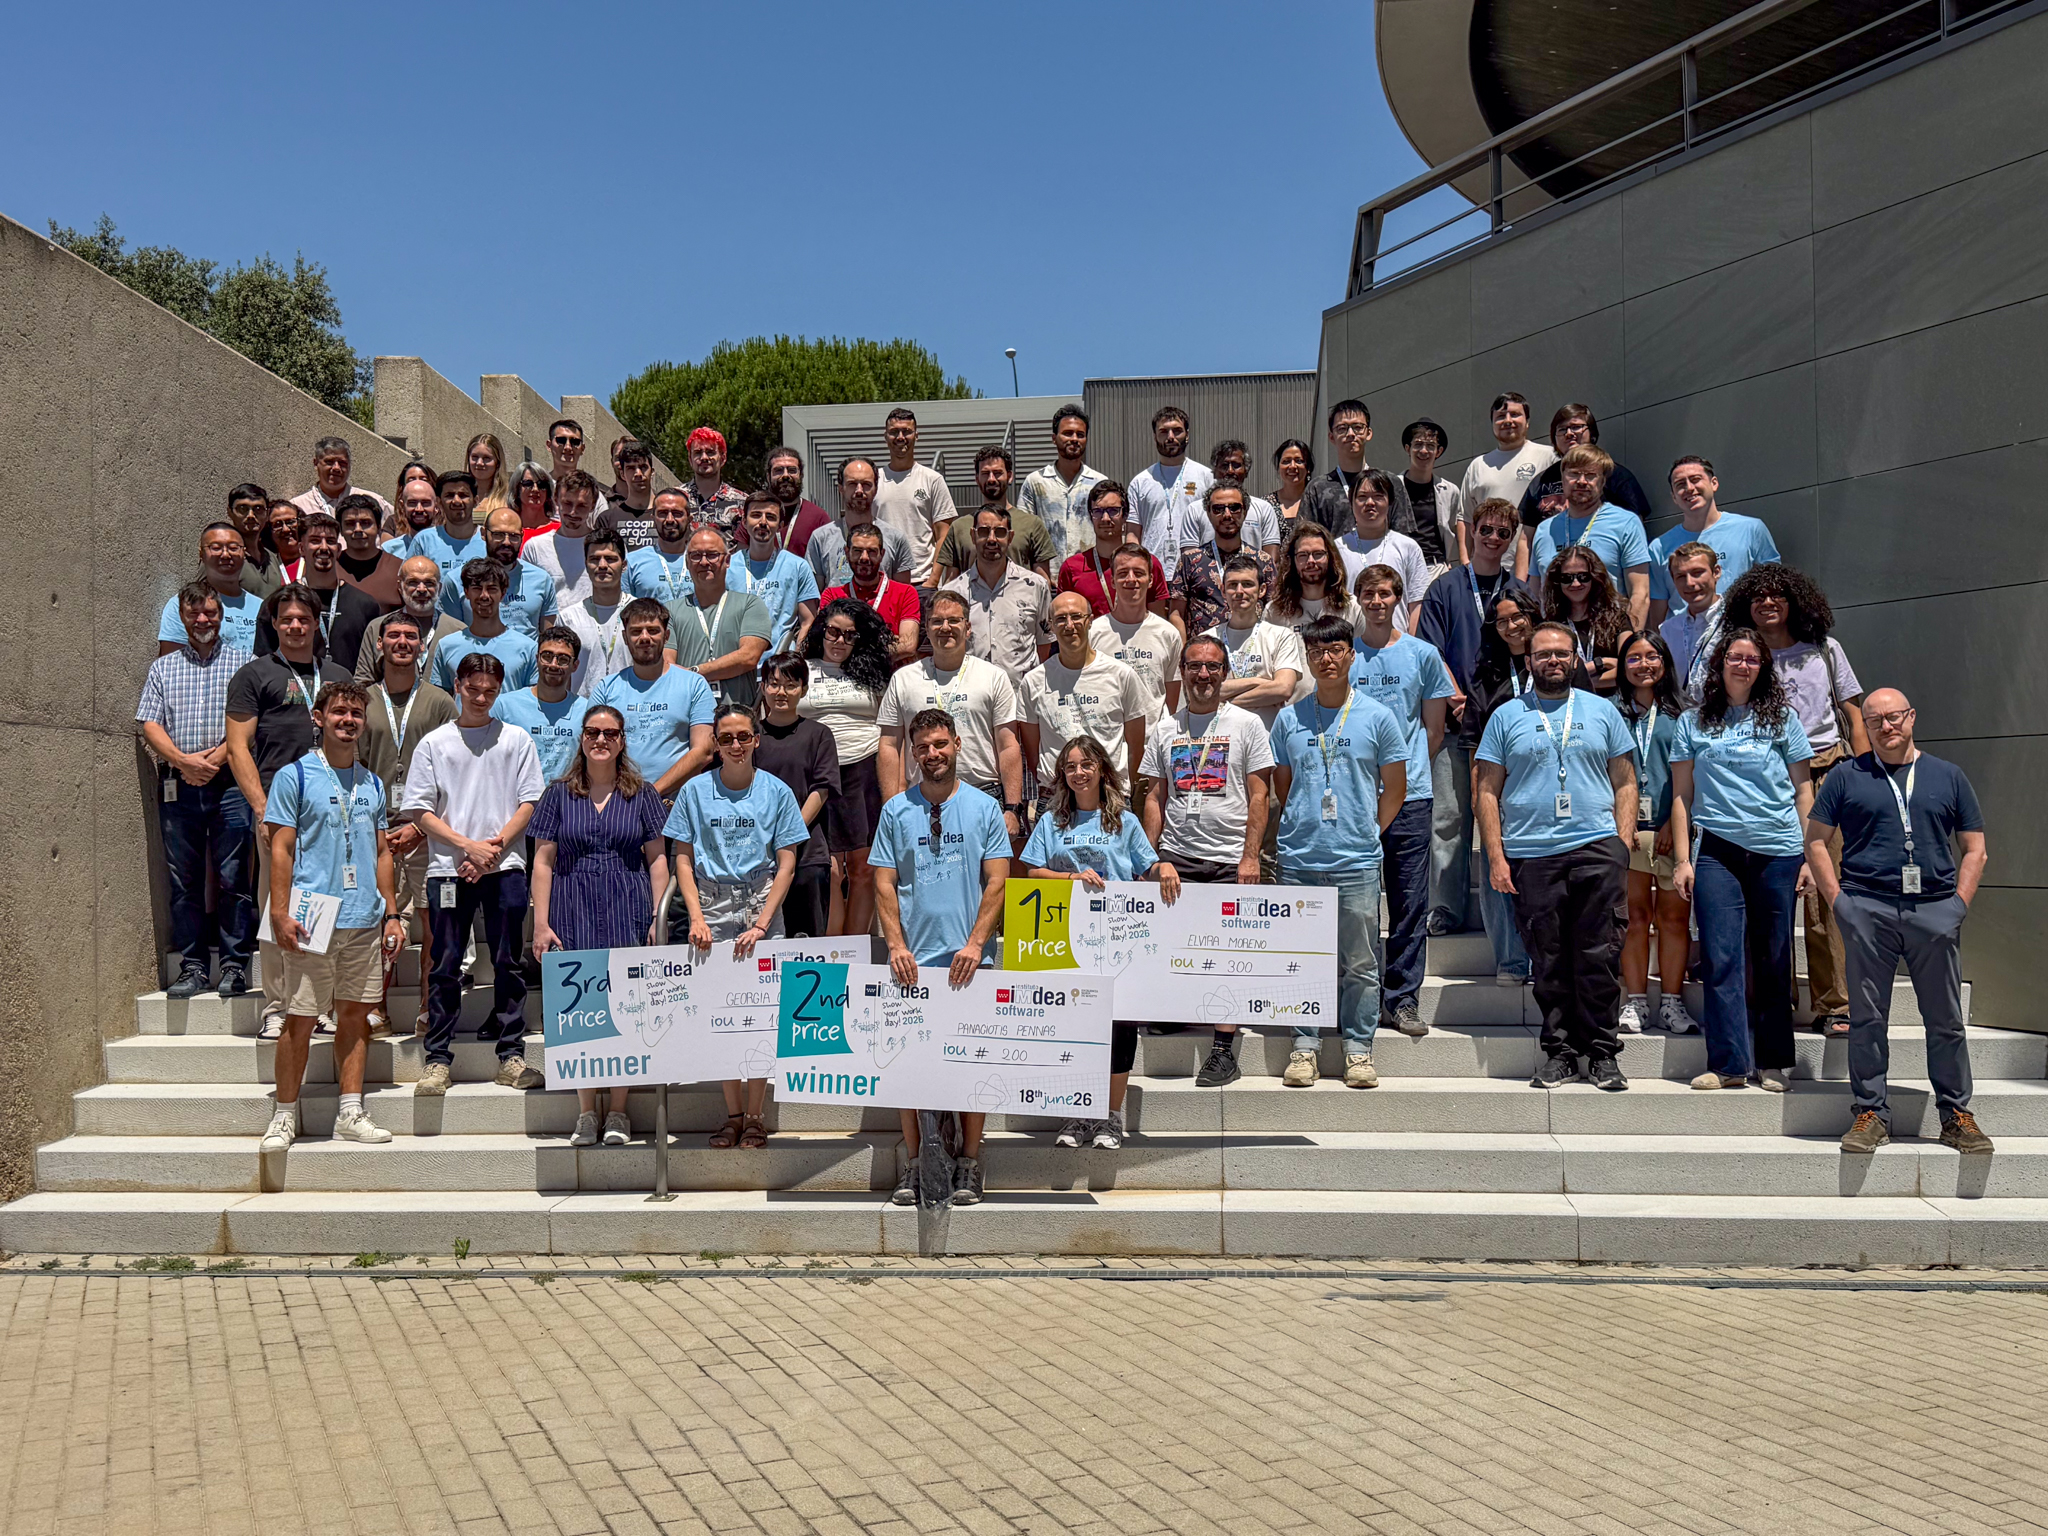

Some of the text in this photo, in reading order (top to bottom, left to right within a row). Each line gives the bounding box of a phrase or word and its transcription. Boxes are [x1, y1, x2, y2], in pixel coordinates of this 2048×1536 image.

[619, 528, 647, 542] ergo
[1018, 888, 1067, 940] 1st
[1107, 916, 1128, 924] show
[1109, 920, 1148, 932] your work
[1221, 917, 1271, 929] software
[1128, 928, 1150, 940] 2026
[1228, 936, 1267, 950] MORENO
[1018, 938, 1067, 963] price
[651, 958, 665, 966] my
[1170, 955, 1301, 974] iou # 300 #
[557, 961, 612, 1016] 3rd
[646, 980, 667, 990] show
[648, 984, 687, 998] your work
[667, 991, 689, 1004] 2026
[726, 991, 771, 1006] GEORGIA
[792, 969, 850, 1022] 2nd
[882, 1001, 903, 1010] show
[883, 1006, 922, 1018] your work
[995, 1004, 1045, 1017] software
[557, 1009, 607, 1036] price
[710, 1015, 735, 1027] iou
[742, 1015, 756, 1028] #
[902, 1015, 924, 1026] 2026
[792, 1022, 840, 1047] price
[1016, 1024, 1056, 1037] PENNAS
[943, 1042, 1074, 1063] iou # 200 #
[555, 1051, 652, 1080] winner
[786, 1066, 880, 1096] winner
